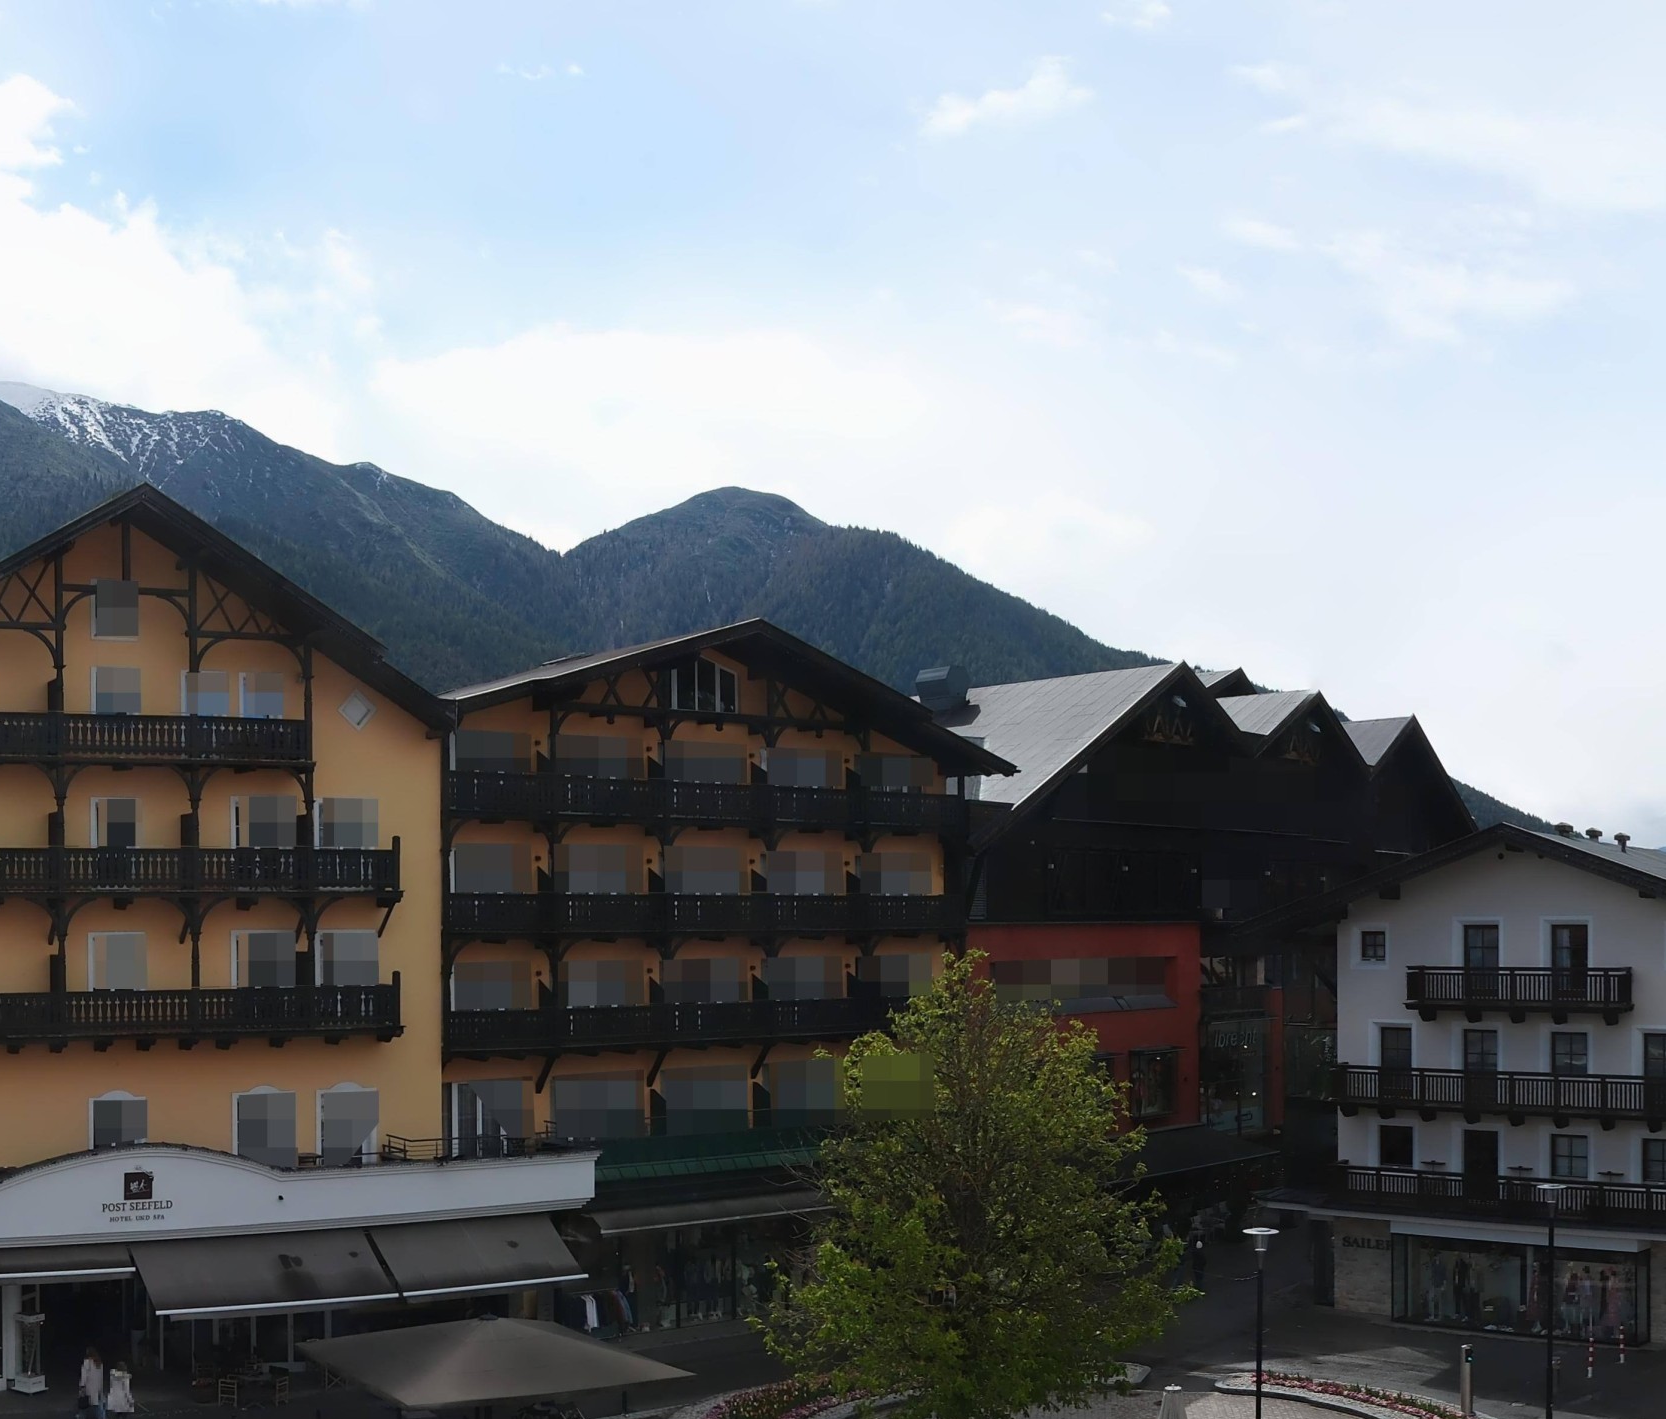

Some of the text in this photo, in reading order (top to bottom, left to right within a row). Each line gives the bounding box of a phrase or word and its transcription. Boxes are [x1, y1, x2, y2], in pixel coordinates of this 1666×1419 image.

[102, 1200, 173, 1213] POST SEEFELD
[109, 1215, 133, 1223] HOTEL
